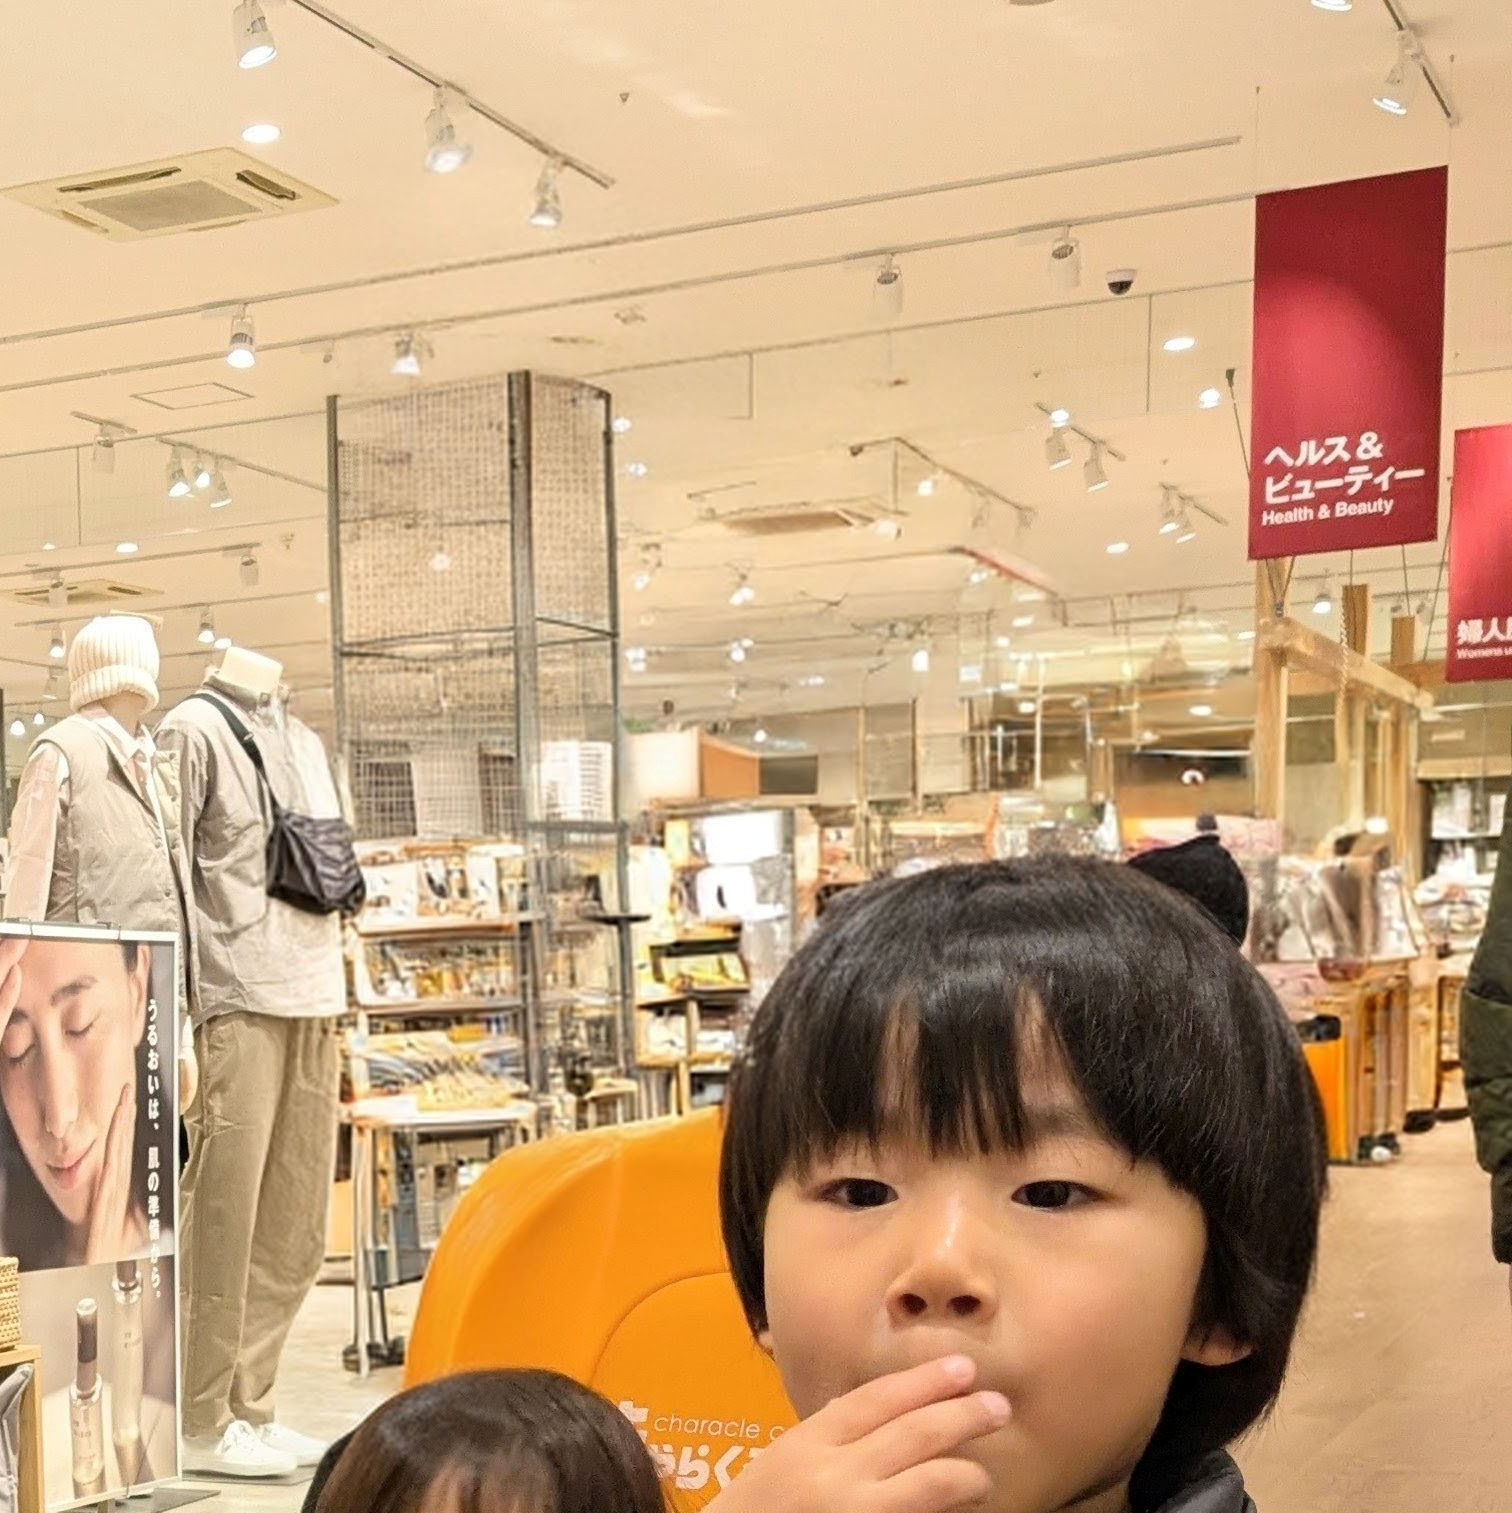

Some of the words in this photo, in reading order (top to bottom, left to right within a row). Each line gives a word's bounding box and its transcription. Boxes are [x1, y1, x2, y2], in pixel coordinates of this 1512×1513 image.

[1265, 465, 1426, 505] ビューティー
[1262, 506, 1314, 526] Health
[1317, 503, 1331, 520] &
[1335, 497, 1394, 517] Beauty
[1457, 616, 1512, 645] 婦人
